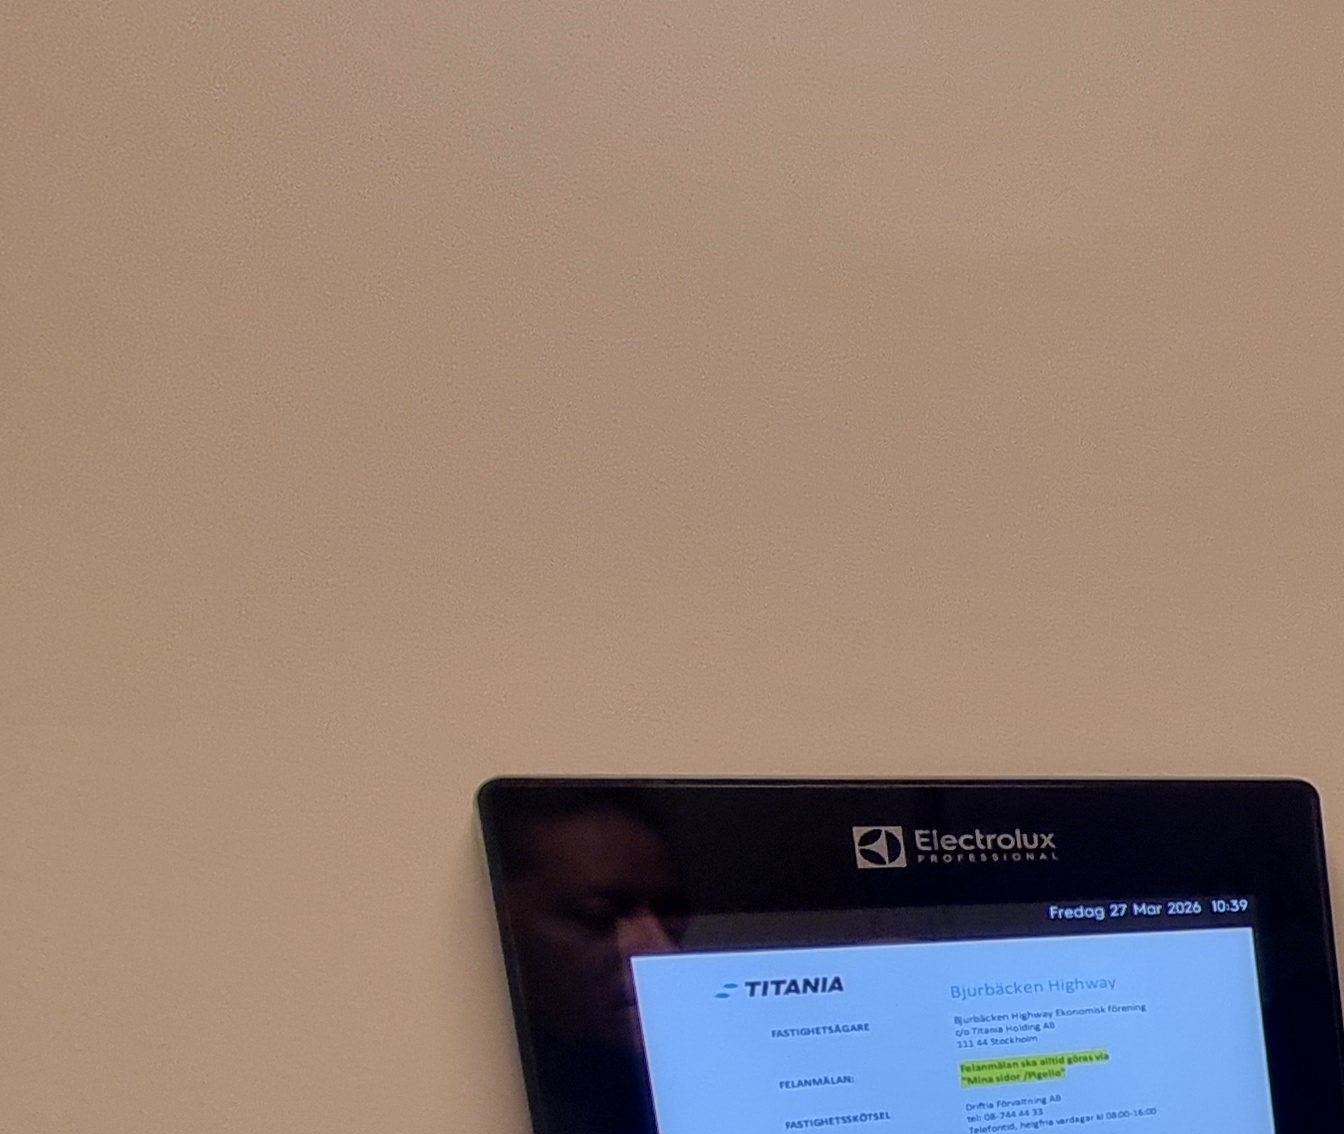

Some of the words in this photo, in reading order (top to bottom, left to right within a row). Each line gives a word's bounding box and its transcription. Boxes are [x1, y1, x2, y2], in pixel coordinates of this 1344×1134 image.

[914, 828, 1056, 851] Electrolux
[916, 851, 1059, 864] PROFESSIONAL
[1048, 904, 1105, 921] Fredag
[1109, 903, 1128, 918] 27
[1132, 902, 1163, 917] Mar
[1166, 901, 1202, 915] 2026
[1211, 899, 1249, 913] 10:39
[744, 976, 844, 998] TITANIA
[950, 981, 1044, 1001] Bjurbäcken
[1048, 977, 1117, 994] Highway
[953, 1013, 1010, 1027] Bjurbäcken
[1010, 1010, 1053, 1022] Highway
[1054, 1005, 1106, 1017] Ekonomisk
[1107, 1004, 1147, 1013] förening
[955, 1028, 971, 1038] c/o
[971, 1026, 1004, 1035] Titania
[1005, 1023, 1042, 1033] Holding
[1042, 1021, 1056, 1030] AB
[957, 1039, 974, 1049] 111
[976, 1038, 989, 1047] 44
[990, 1035, 1039, 1046] Stockholm
[959, 1061, 1019, 1074] Felanmälan
[1020, 1058, 1038, 1068] ska
[1039, 1055, 1065, 1066] alltid
[1066, 1054, 1094, 1066] göras
[1094, 1052, 1110, 1061] via
[779, 1075, 855, 1089] FELANMÄLAN:
[995, 1073, 1021, 1083] sidor
[965, 1101, 995, 1112] Driftia
[996, 1096, 1048, 1108] Förvaltning
[1049, 1094, 1062, 1102] AB
[785, 1111, 891, 1130] FASTIGHETSSKÖTSEL
[983, 1110, 1017, 1122] 08-744
[1018, 1109, 1030, 1117] 44
[1032, 1107, 1044, 1117] 33
[1019, 1118, 1054, 1130] helgfria
[1055, 1115, 1094, 1125] vardagar
